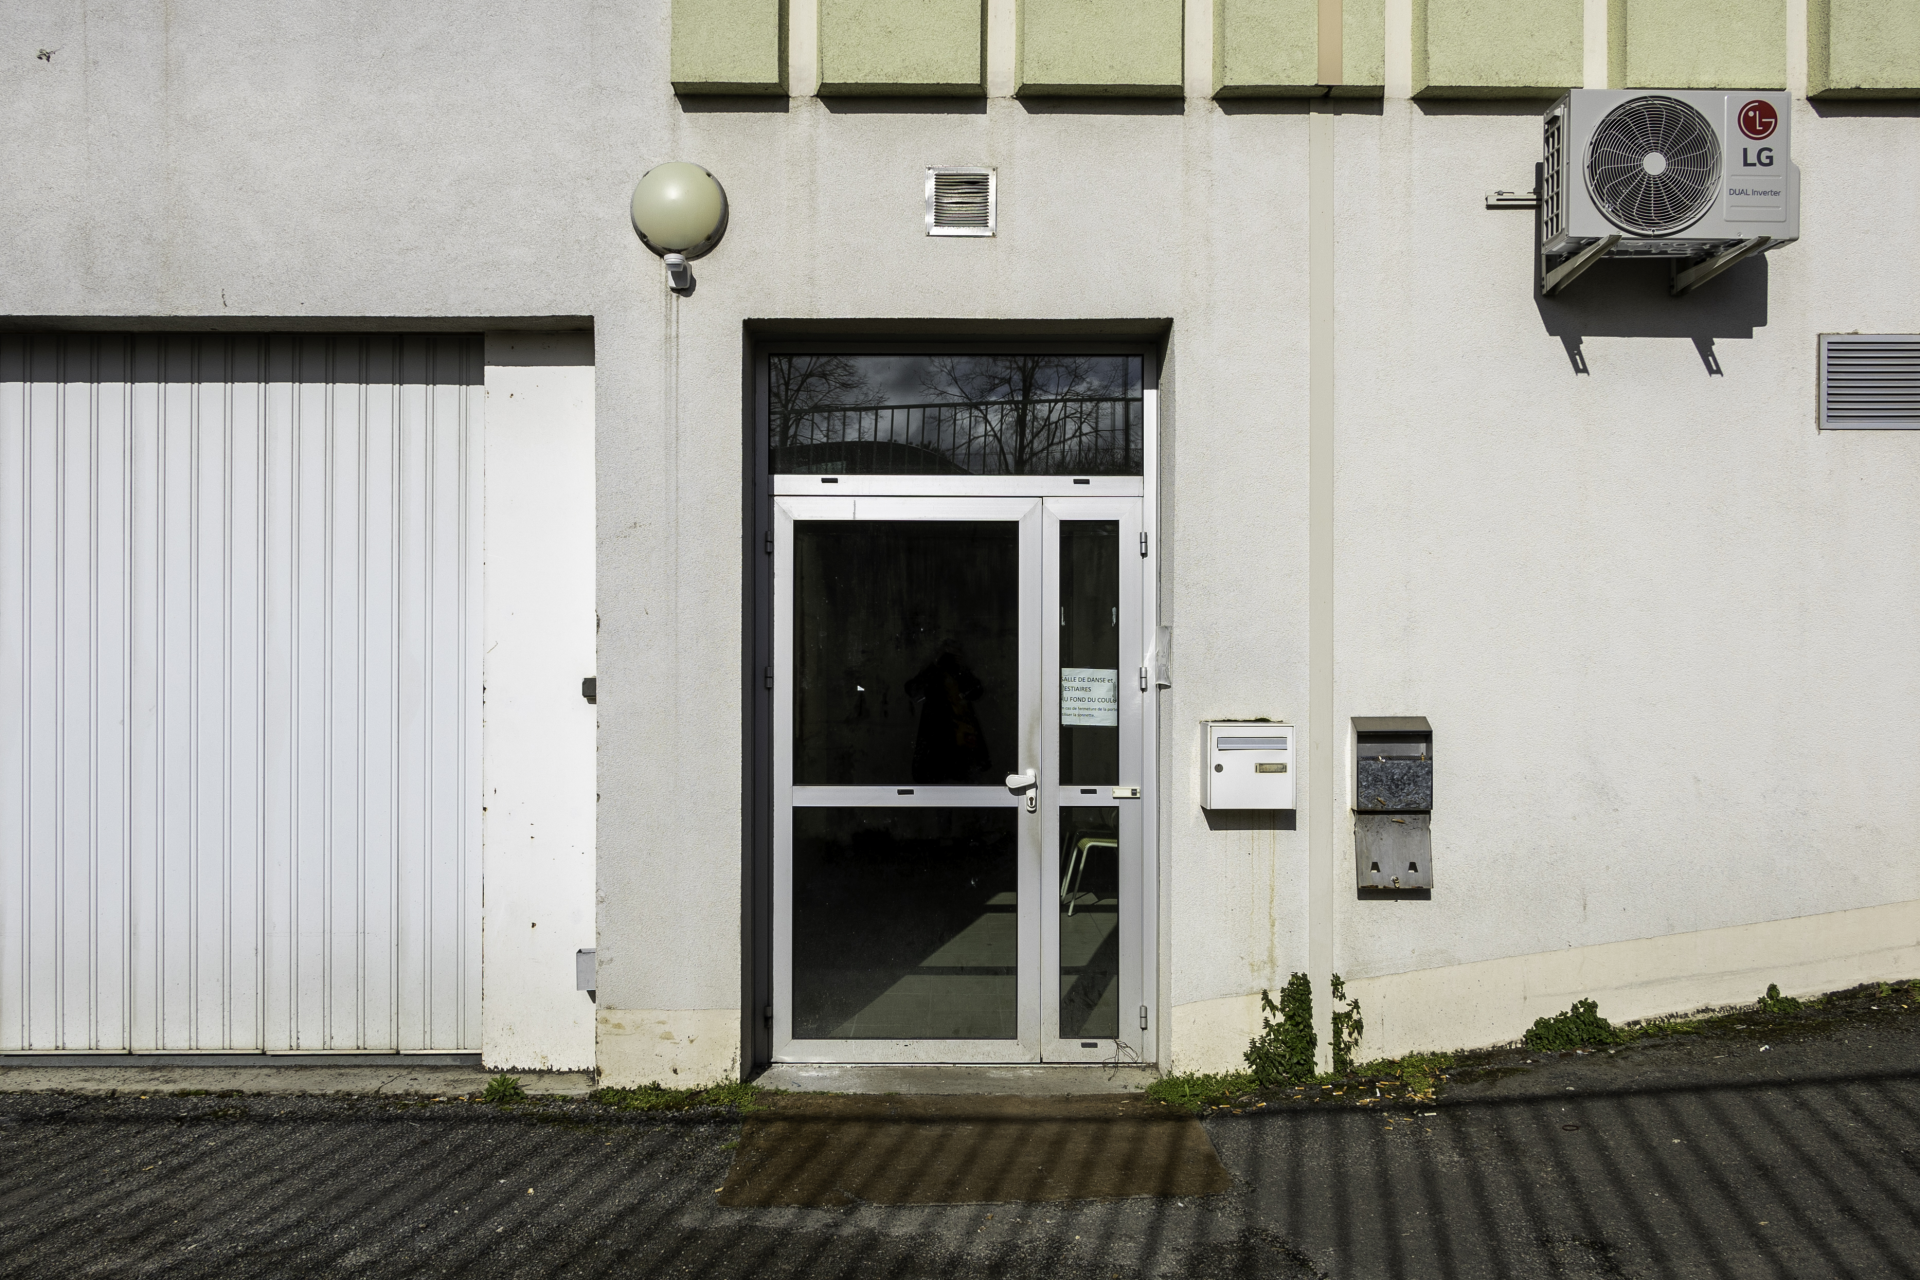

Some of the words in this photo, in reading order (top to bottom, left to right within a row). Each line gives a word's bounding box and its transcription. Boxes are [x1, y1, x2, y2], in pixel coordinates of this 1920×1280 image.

[1742, 147, 1774, 167] LG
[1729, 188, 1750, 196] DUAL
[1751, 188, 1781, 196] Inverter
